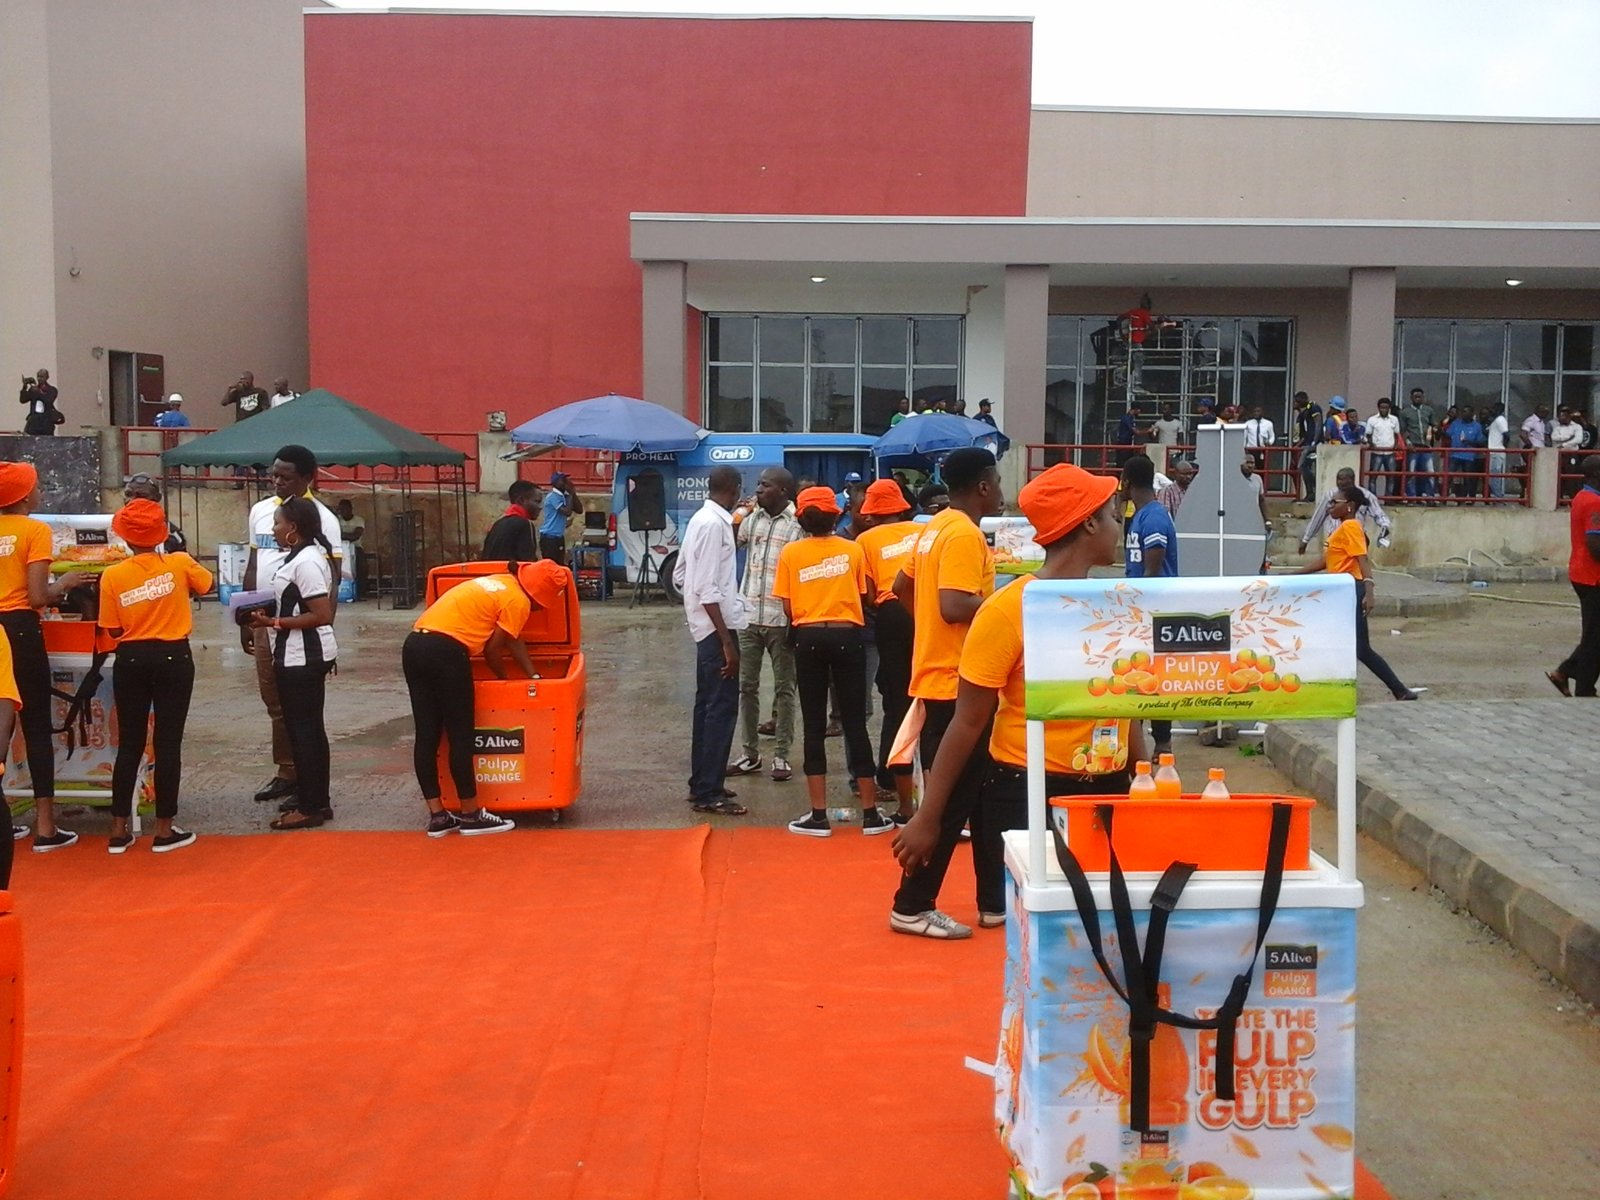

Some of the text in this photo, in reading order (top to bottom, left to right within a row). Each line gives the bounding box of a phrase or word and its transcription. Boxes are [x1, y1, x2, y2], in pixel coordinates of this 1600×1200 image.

[1160, 624, 1224, 642] 5 Alive
[1165, 657, 1220, 677] Pulpy
[1161, 679, 1225, 692] ORANGE
[1142, 700, 1169, 712] product
[1171, 700, 1180, 711] of
[474, 735, 520, 748] 5 Alive
[478, 757, 518, 772] Pulpy
[475, 772, 521, 783] ORANGE
[1270, 951, 1312, 963] 5 Alive
[1271, 971, 1309, 985] Pulpy
[1270, 987, 1312, 996] ORANGE
[1271, 1008, 1317, 1029] THE
[1236, 1067, 1317, 1091] EVERY
[1199, 1090, 1317, 1128] GULP
